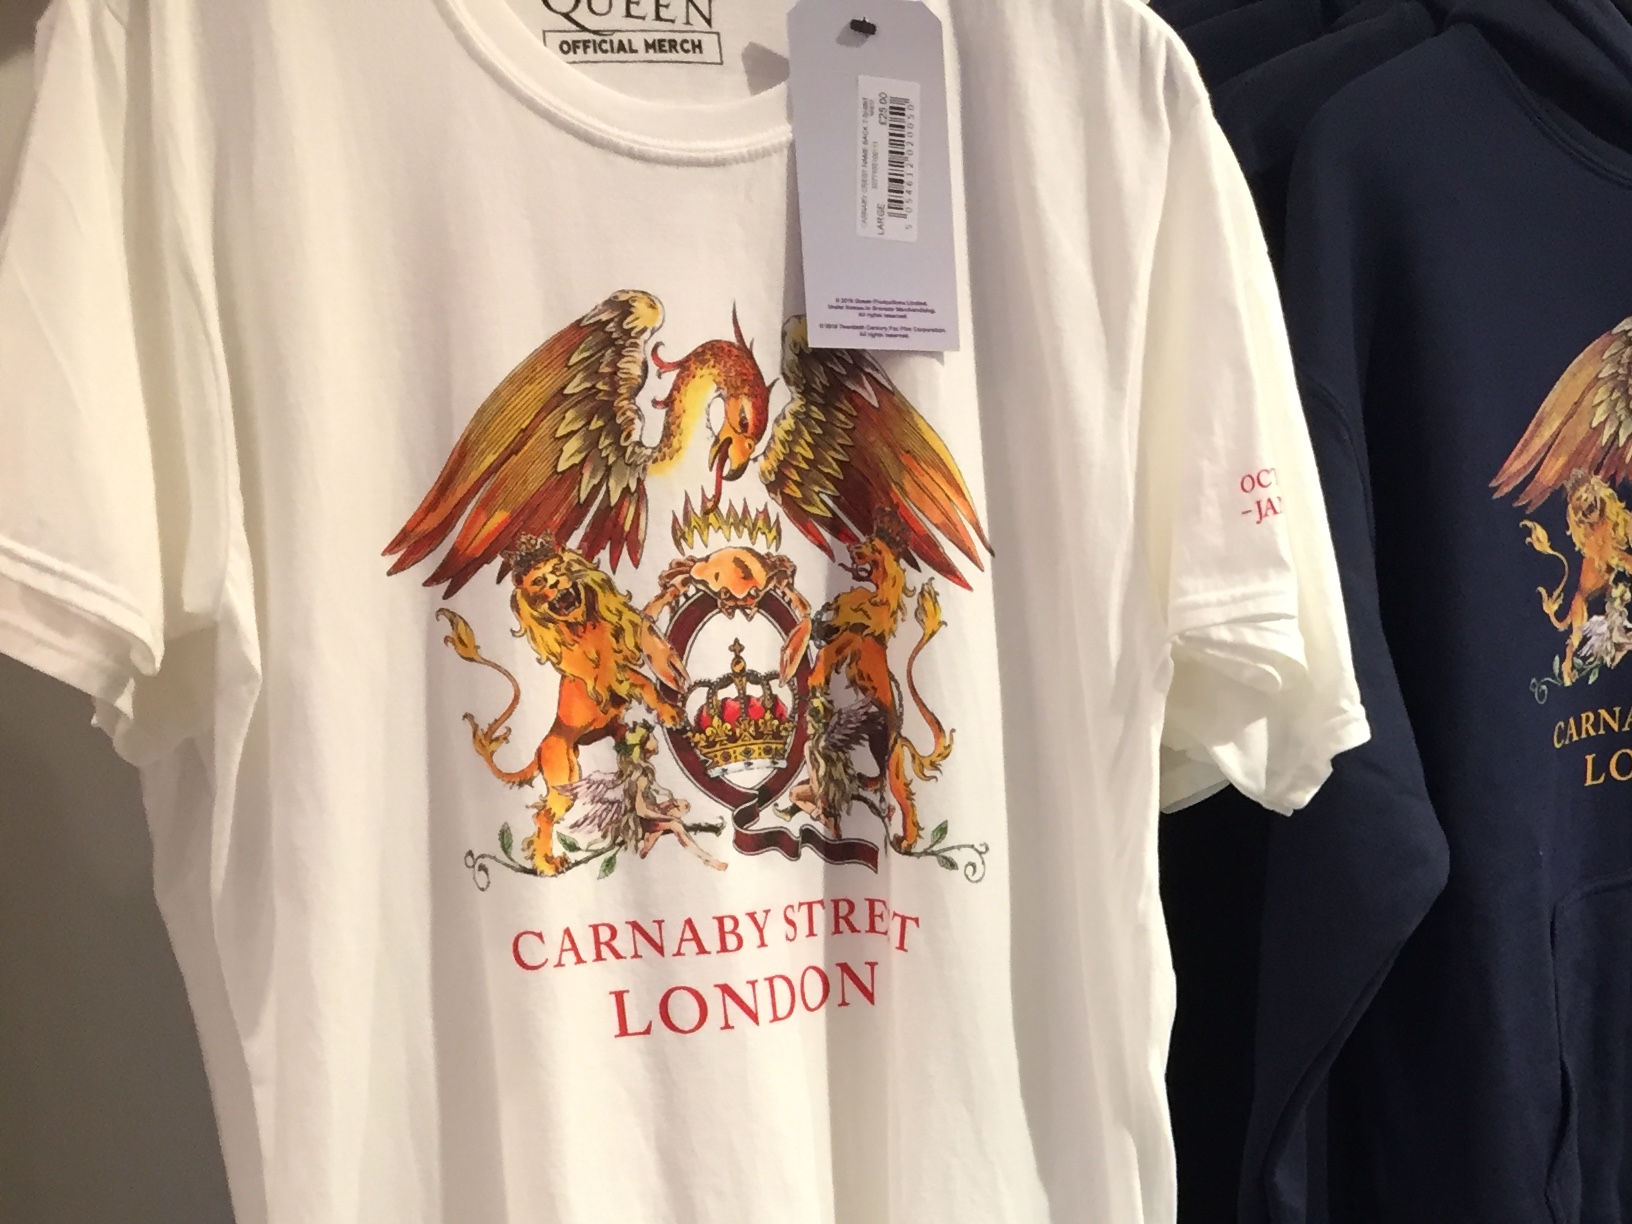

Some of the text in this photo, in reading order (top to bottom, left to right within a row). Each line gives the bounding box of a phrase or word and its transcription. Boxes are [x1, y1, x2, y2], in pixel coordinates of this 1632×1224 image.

[540, 0, 714, 37] QUEEN
[558, 38, 704, 56] OFFICIAL MERCH
[876, 202, 887, 236] LARGE
[511, 896, 920, 972] CARNABY STRET
[608, 960, 879, 1039] LONDON
